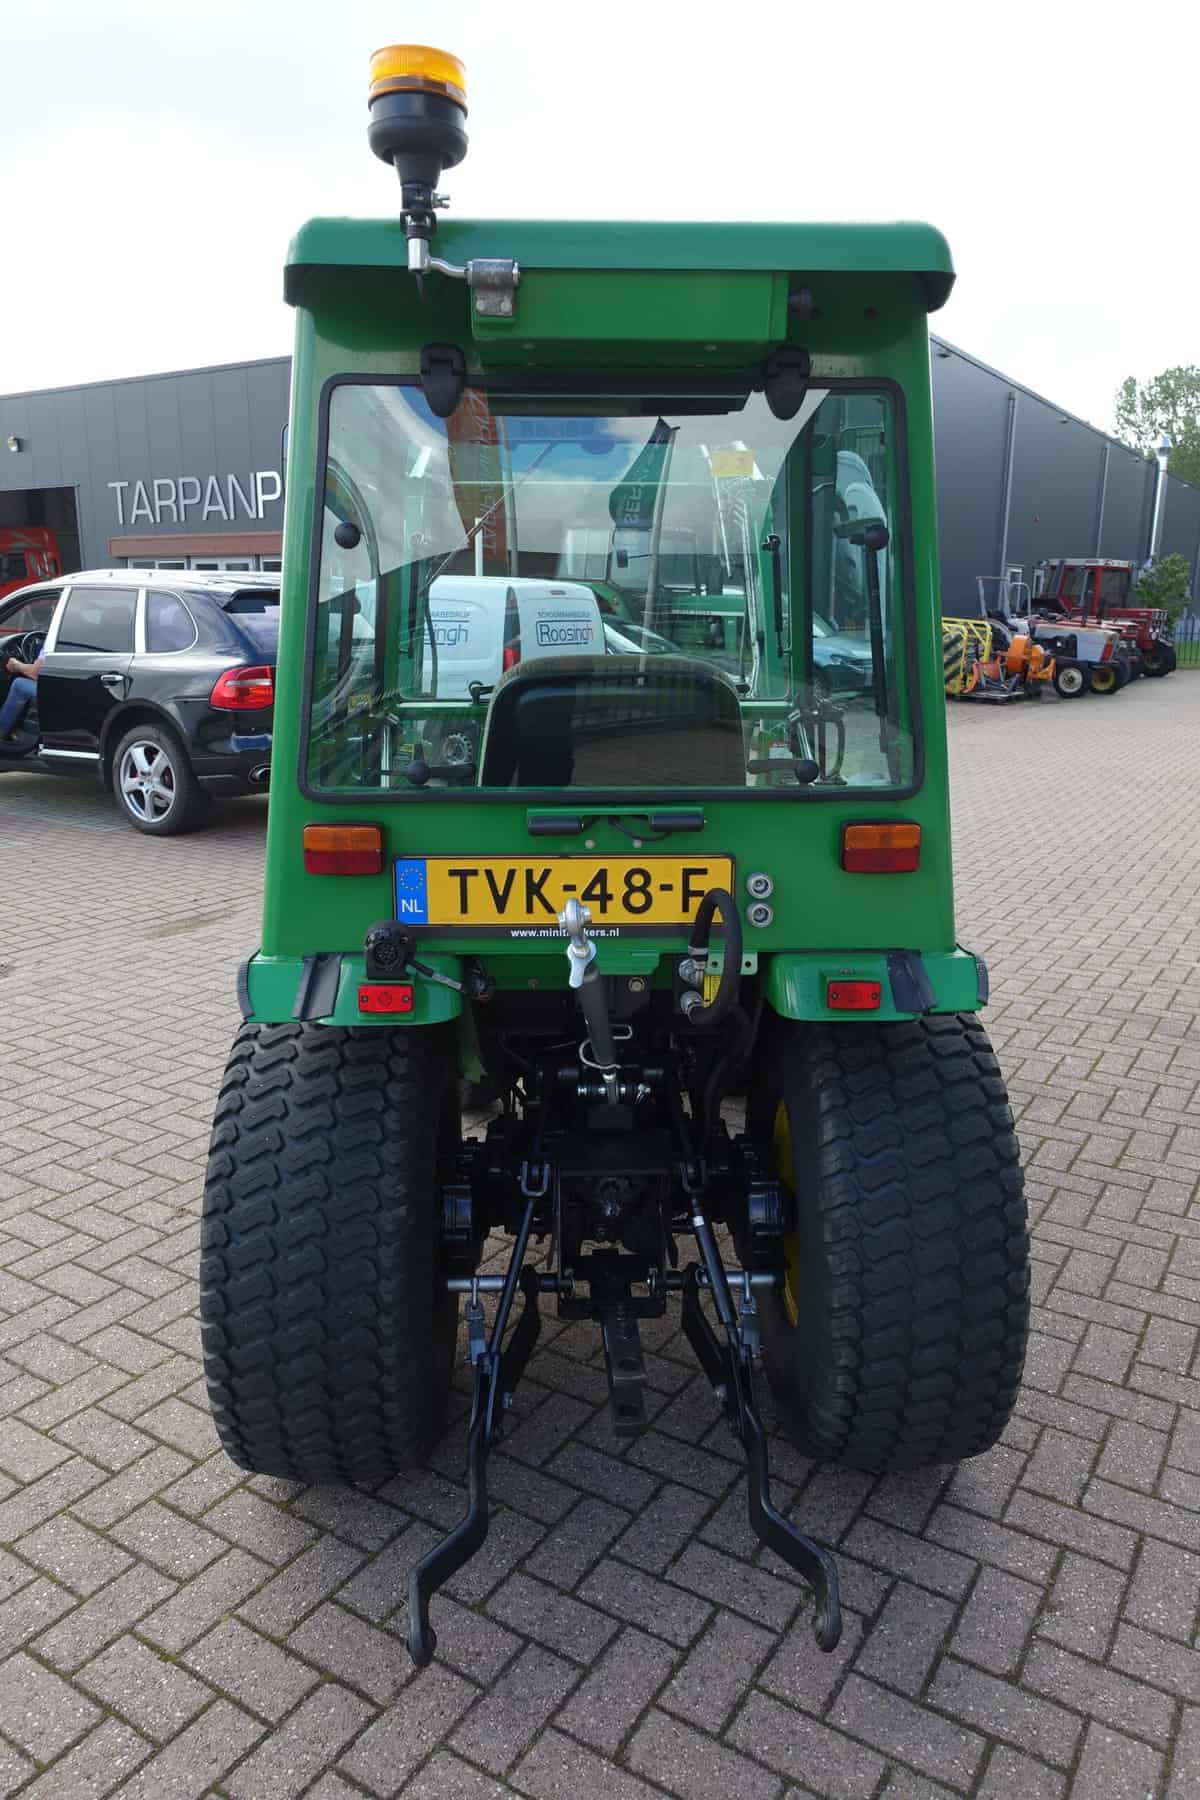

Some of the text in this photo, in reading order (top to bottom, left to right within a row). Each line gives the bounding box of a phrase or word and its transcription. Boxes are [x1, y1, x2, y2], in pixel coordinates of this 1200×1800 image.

[448, 868, 708, 914] TVK-48-F
[401, 899, 423, 913] NL
[511, 928, 619, 937] www.minitkers.nl
